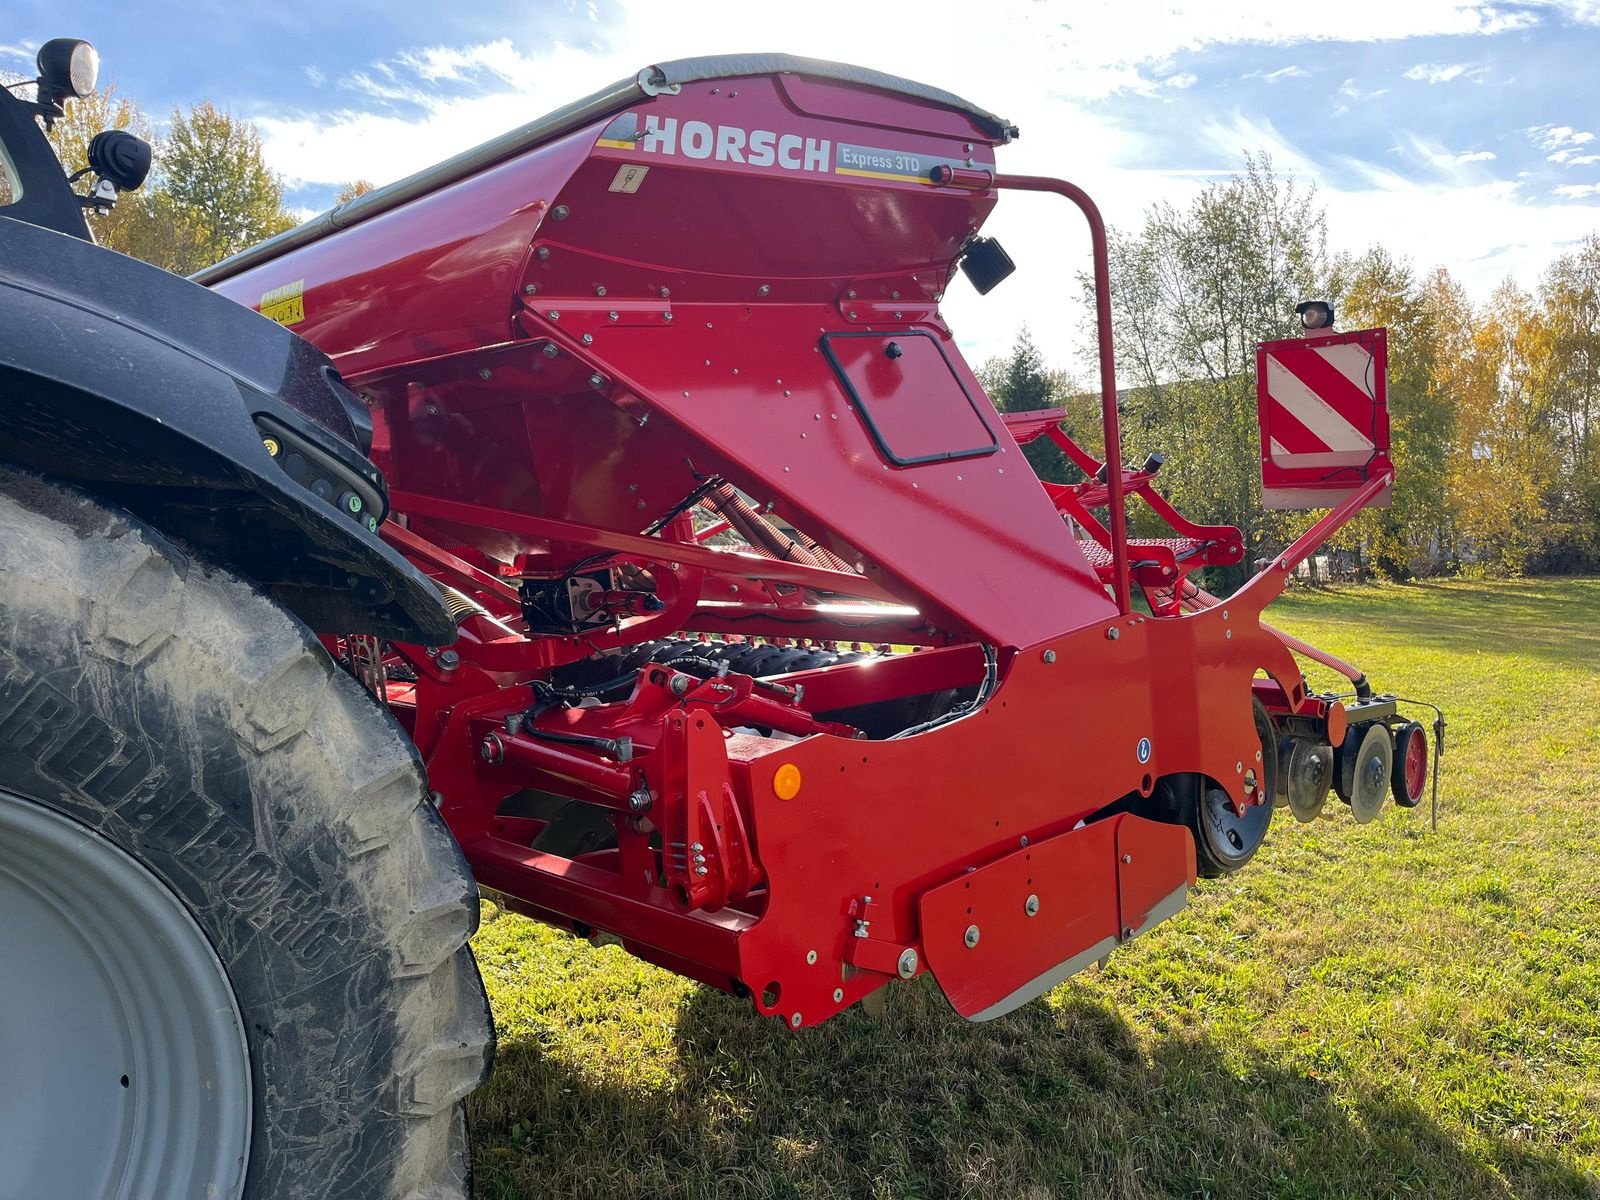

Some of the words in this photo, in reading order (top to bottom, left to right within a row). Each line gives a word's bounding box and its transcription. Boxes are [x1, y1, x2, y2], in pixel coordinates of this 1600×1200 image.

[645, 115, 830, 172] HORSCH
[842, 148, 892, 169] Express
[895, 157, 920, 172] 3TD
[0, 648, 352, 970] RELLEBORG
